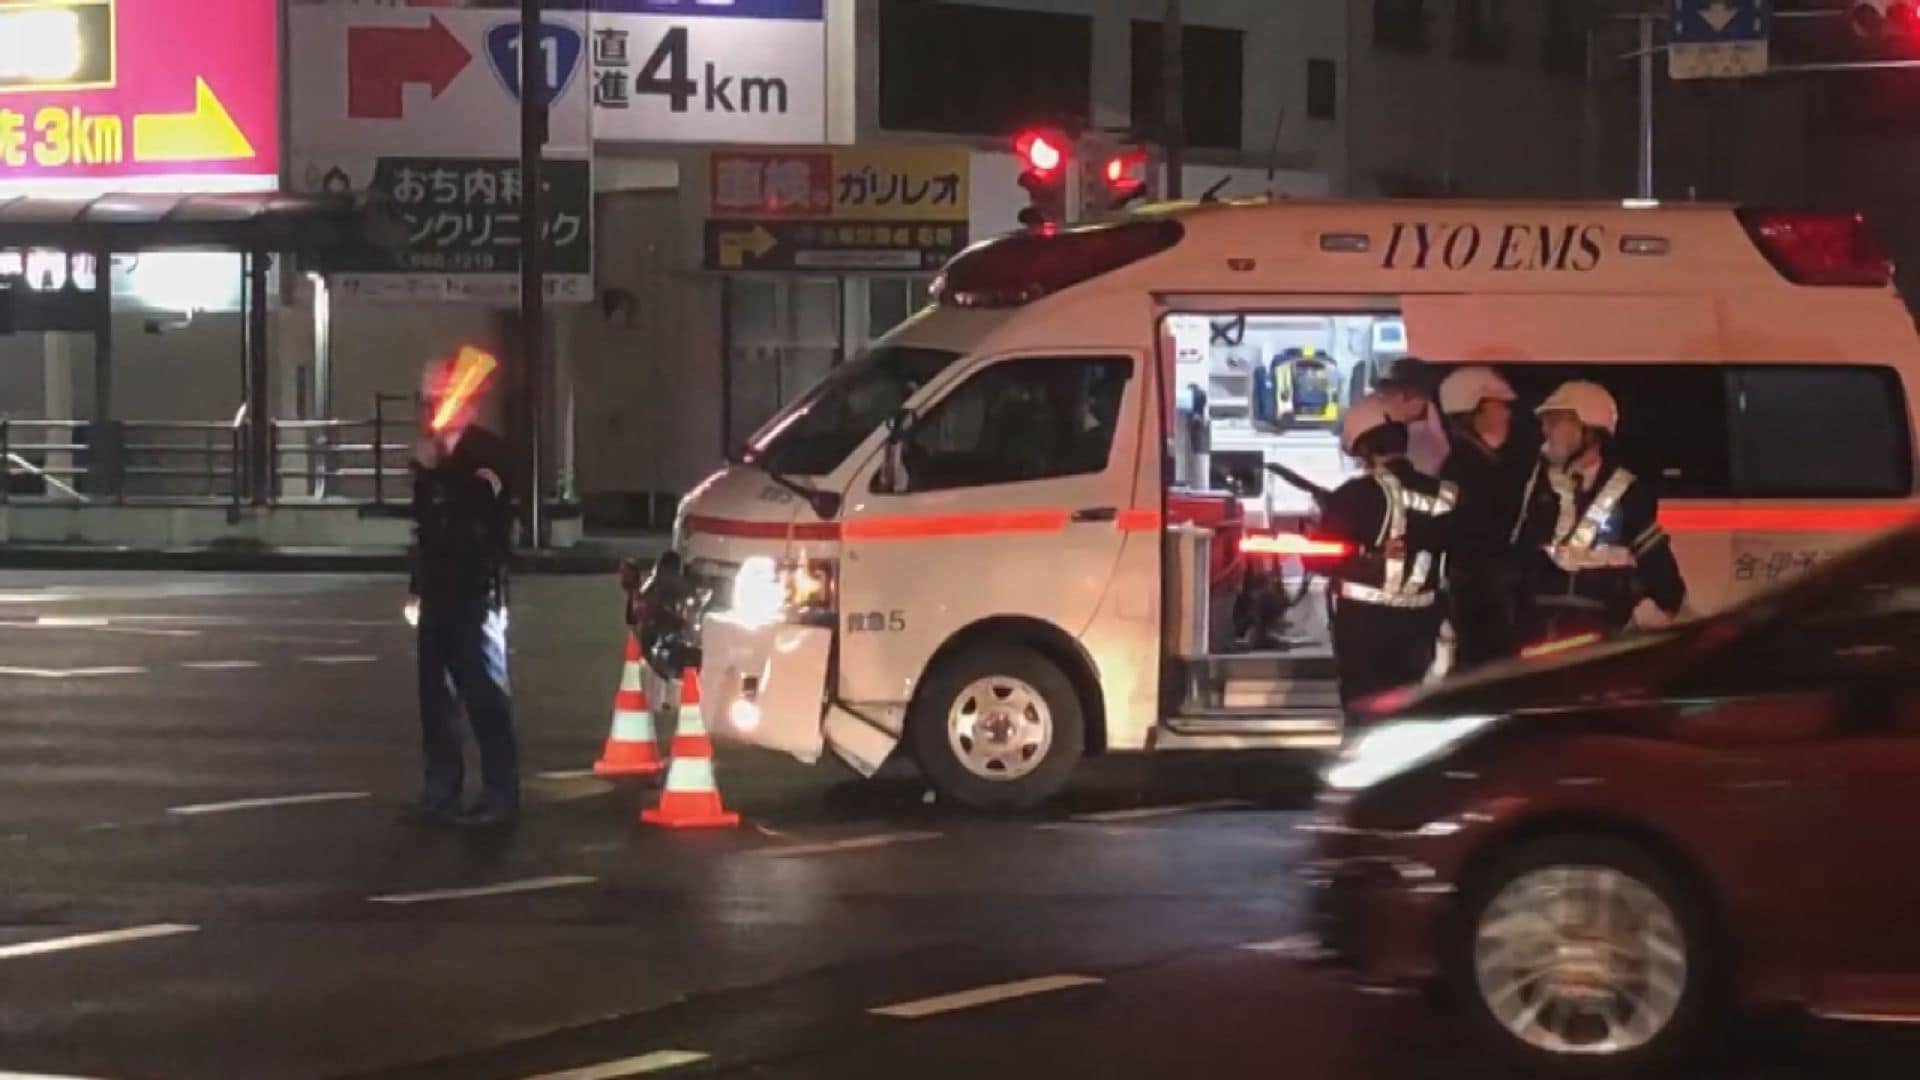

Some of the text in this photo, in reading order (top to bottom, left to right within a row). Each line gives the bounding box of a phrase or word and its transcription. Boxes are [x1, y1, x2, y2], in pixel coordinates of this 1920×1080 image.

[508, 36, 559, 88] 11
[593, 27, 630, 109] 直進
[838, 163, 960, 206] ガリレオ
[404, 212, 581, 247] ンクリニク
[1381, 222, 1605, 271] IYO EMS
